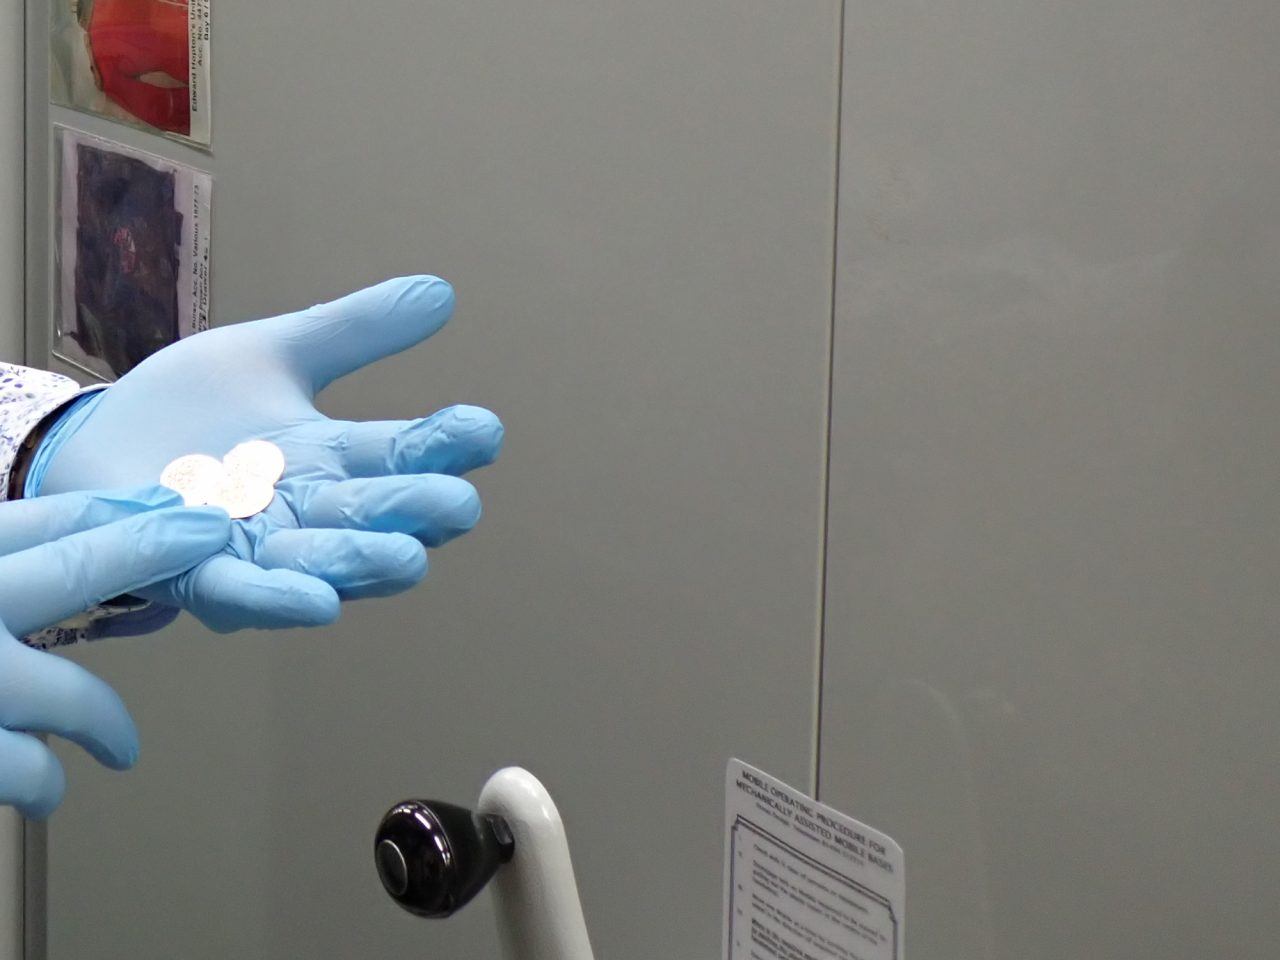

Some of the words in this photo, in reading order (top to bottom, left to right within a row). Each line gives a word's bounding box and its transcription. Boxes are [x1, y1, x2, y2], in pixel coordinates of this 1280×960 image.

[736, 779, 792, 817] MECHANICALLY
[794, 814, 832, 840] ASSISTED
[834, 835, 865, 858] MOBILE
[742, 770, 769, 792] MOBILE
[869, 840, 886, 855] FOR
